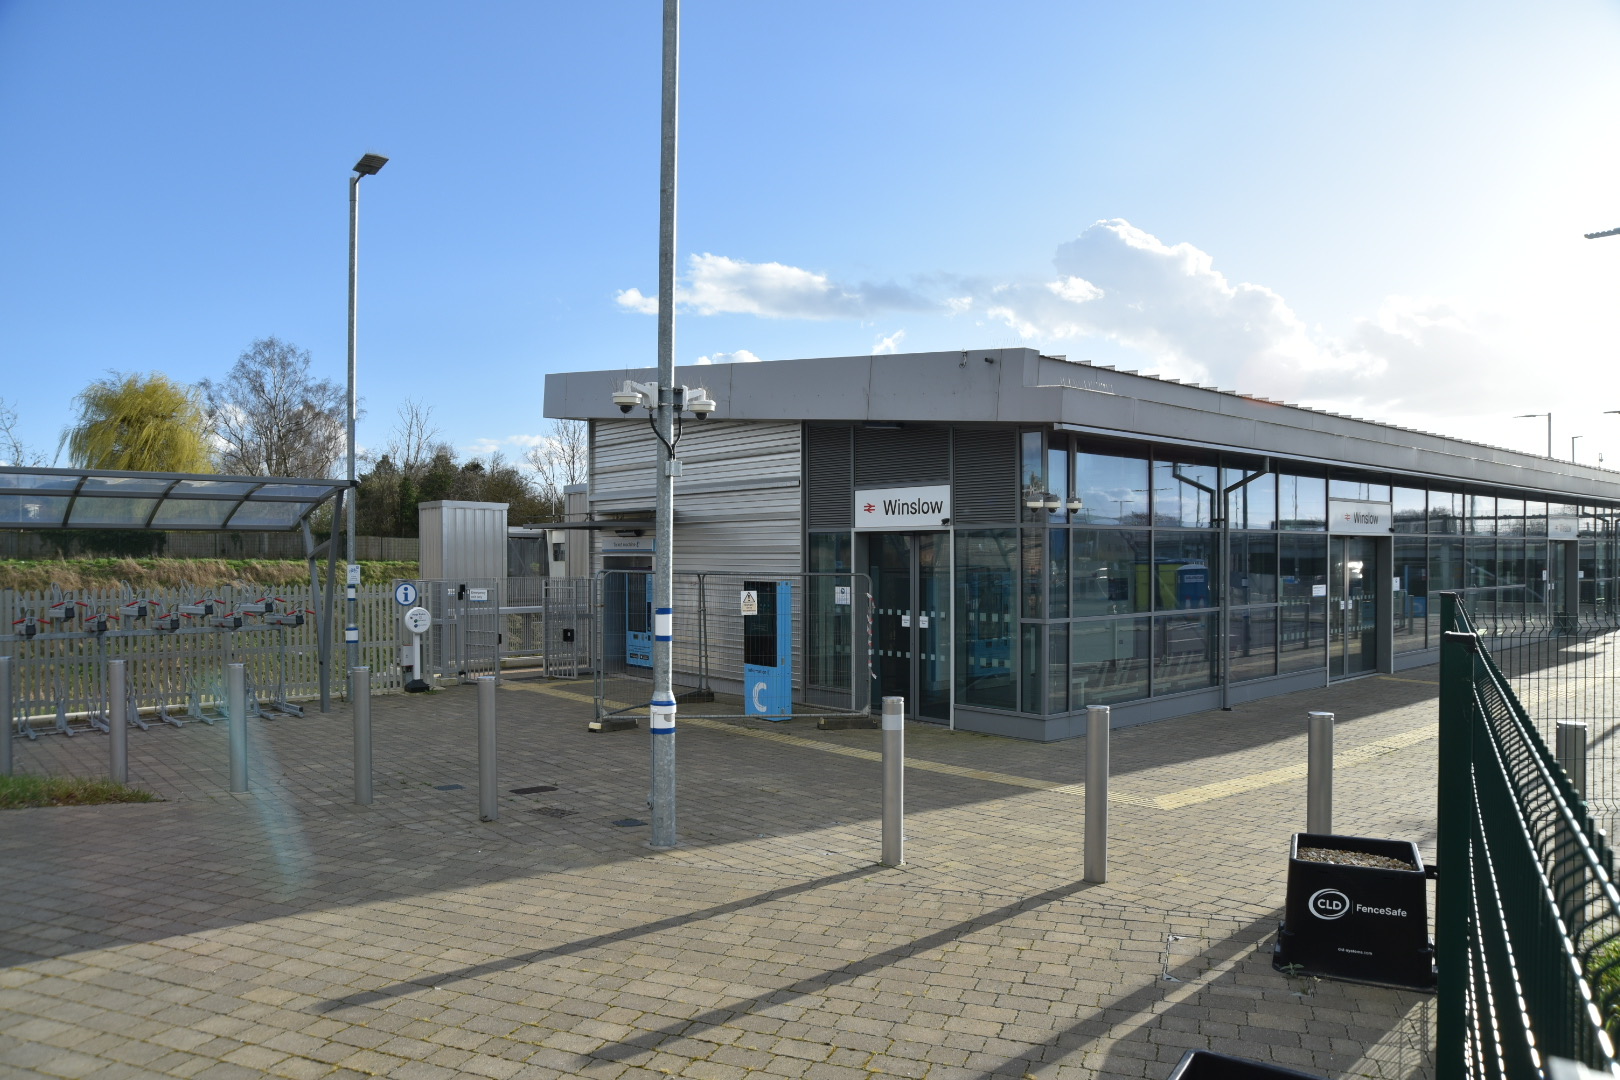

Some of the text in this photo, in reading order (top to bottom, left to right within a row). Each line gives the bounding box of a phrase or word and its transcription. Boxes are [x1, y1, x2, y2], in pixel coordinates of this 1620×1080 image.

[883, 498, 943, 515] Winslow
[1353, 511, 1379, 524] Winslow
[1317, 899, 1342, 910] CLD
[1356, 904, 1407, 917] FenceSafe
